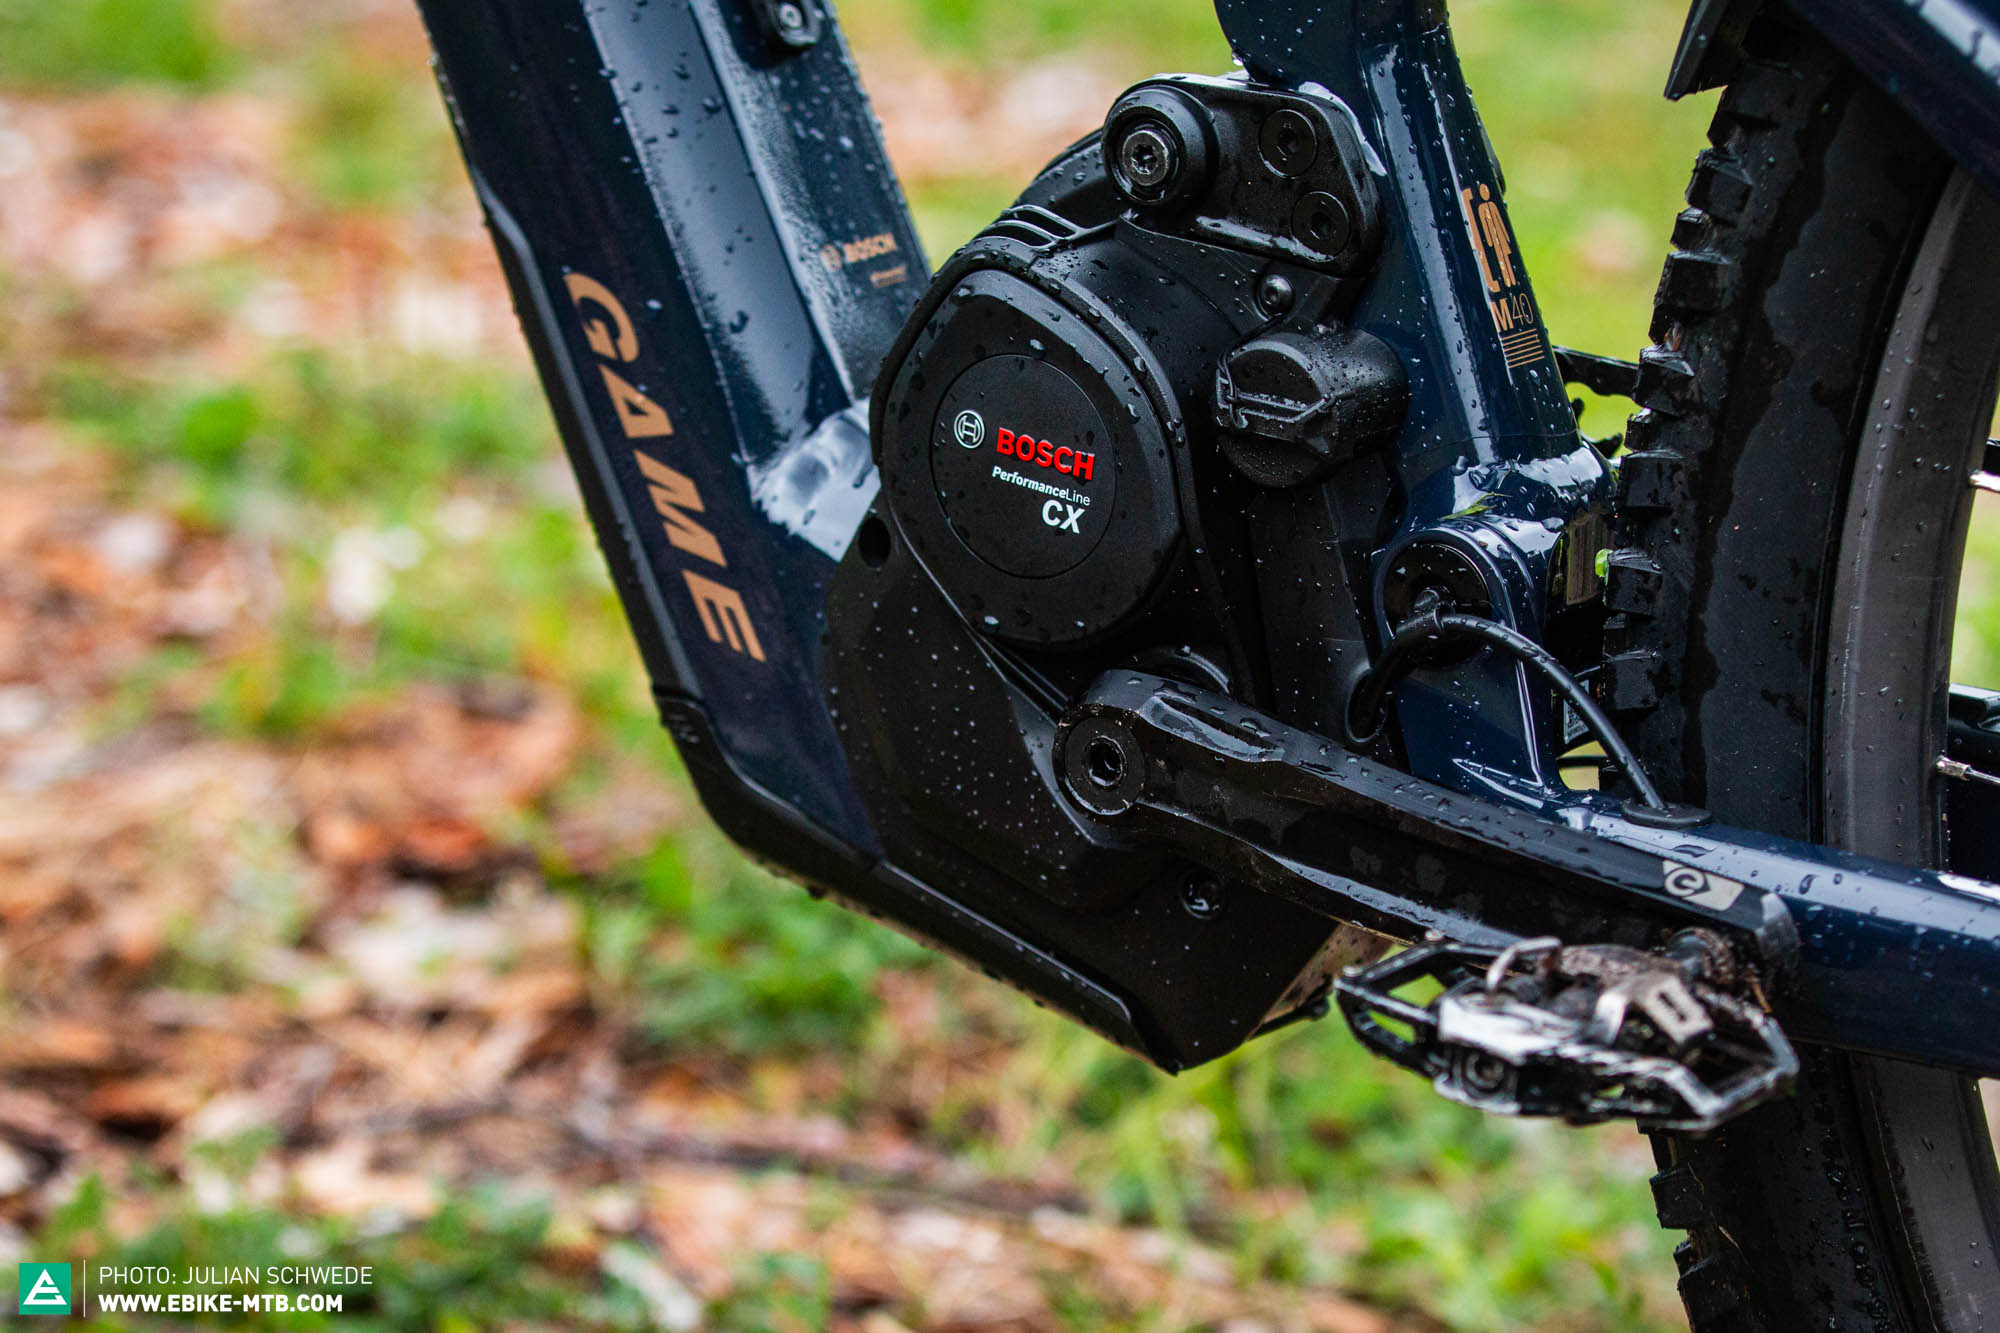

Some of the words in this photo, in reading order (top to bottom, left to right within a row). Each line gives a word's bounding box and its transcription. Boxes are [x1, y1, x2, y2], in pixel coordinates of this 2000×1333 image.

[1489, 293, 1534, 333] M40
[563, 273, 767, 662] GAME
[996, 427, 1096, 480] BOSCH
[1042, 499, 1086, 534] CX
